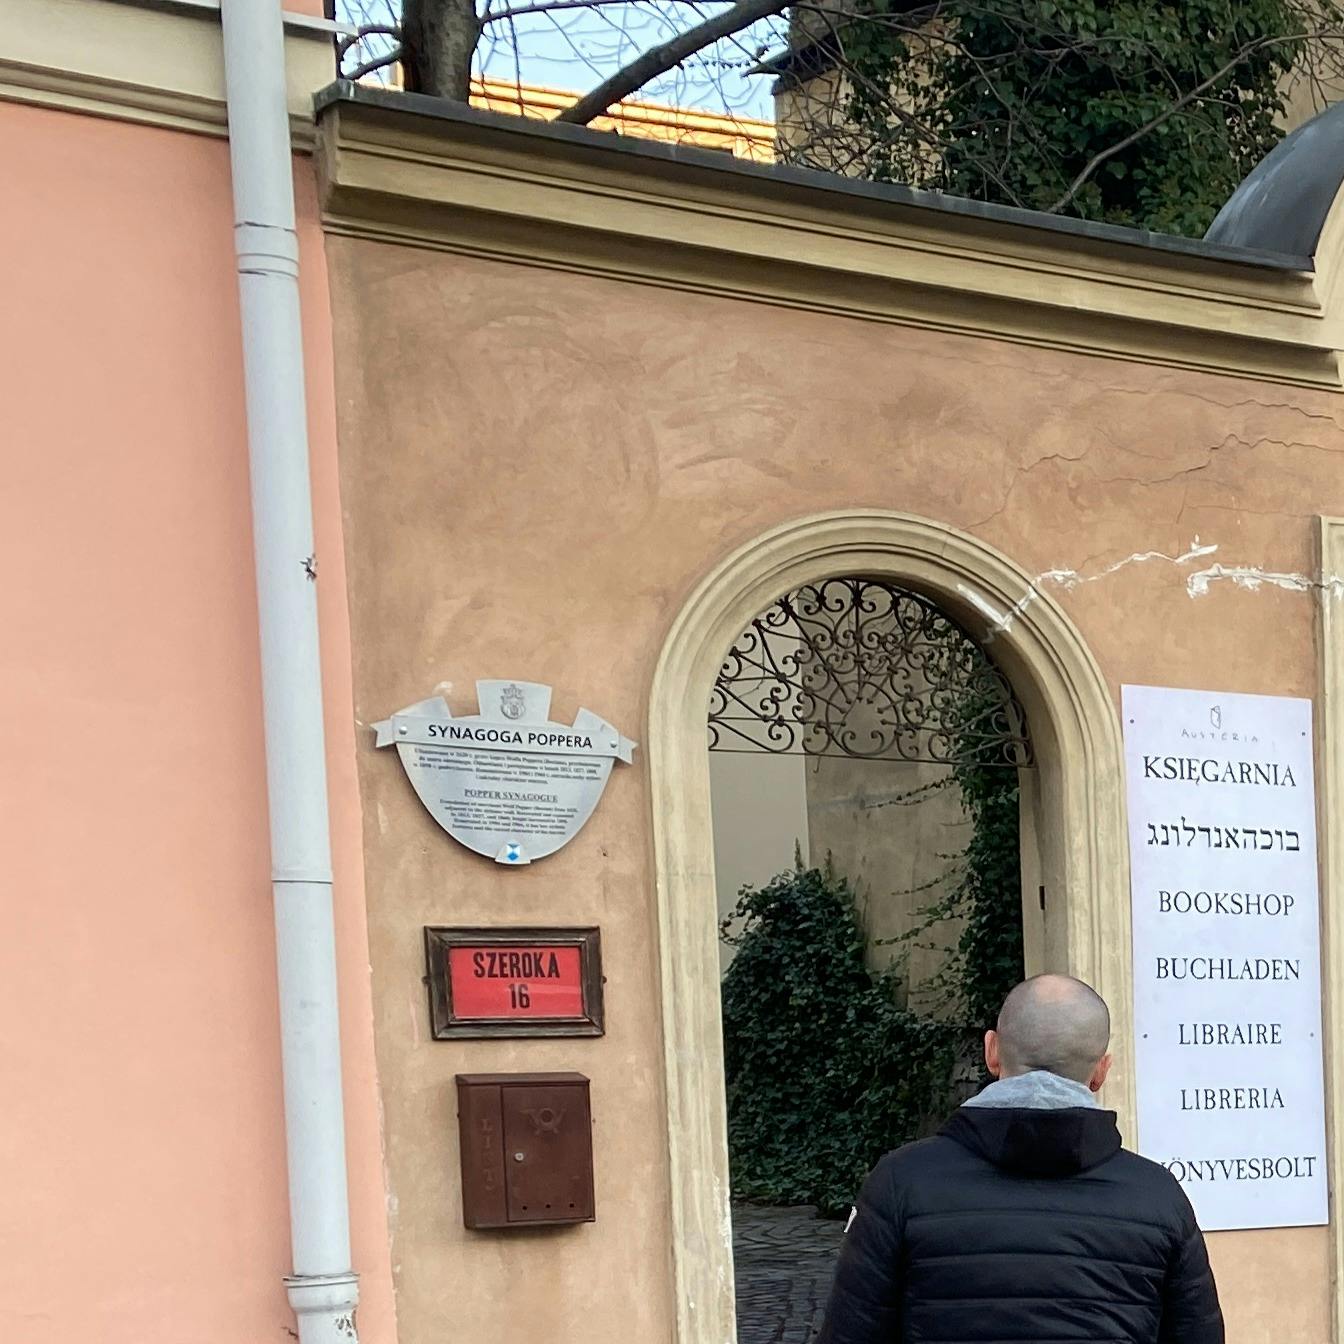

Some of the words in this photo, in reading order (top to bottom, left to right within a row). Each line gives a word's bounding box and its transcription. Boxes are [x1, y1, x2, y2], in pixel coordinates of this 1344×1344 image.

[428, 724, 523, 745] SYNAGOGA
[528, 732, 593, 750] POPPERA
[1143, 755, 1297, 787] KSIĘGARNIA
[464, 788, 500, 801] POPPER
[501, 791, 559, 804] SYNAGOGUE
[1147, 816, 1300, 851] בוכהאנדלונג
[1158, 890, 1295, 916] BOOKSHOP
[473, 951, 560, 979] SZEROKA
[1156, 957, 1301, 981] BUCHLADEN
[508, 983, 531, 1010] 16
[1178, 1023, 1283, 1045] LIBRAIRE
[1180, 1087, 1285, 1110] LIBRERIA
[1161, 1156, 1317, 1182] ÖNYVESBOLT
